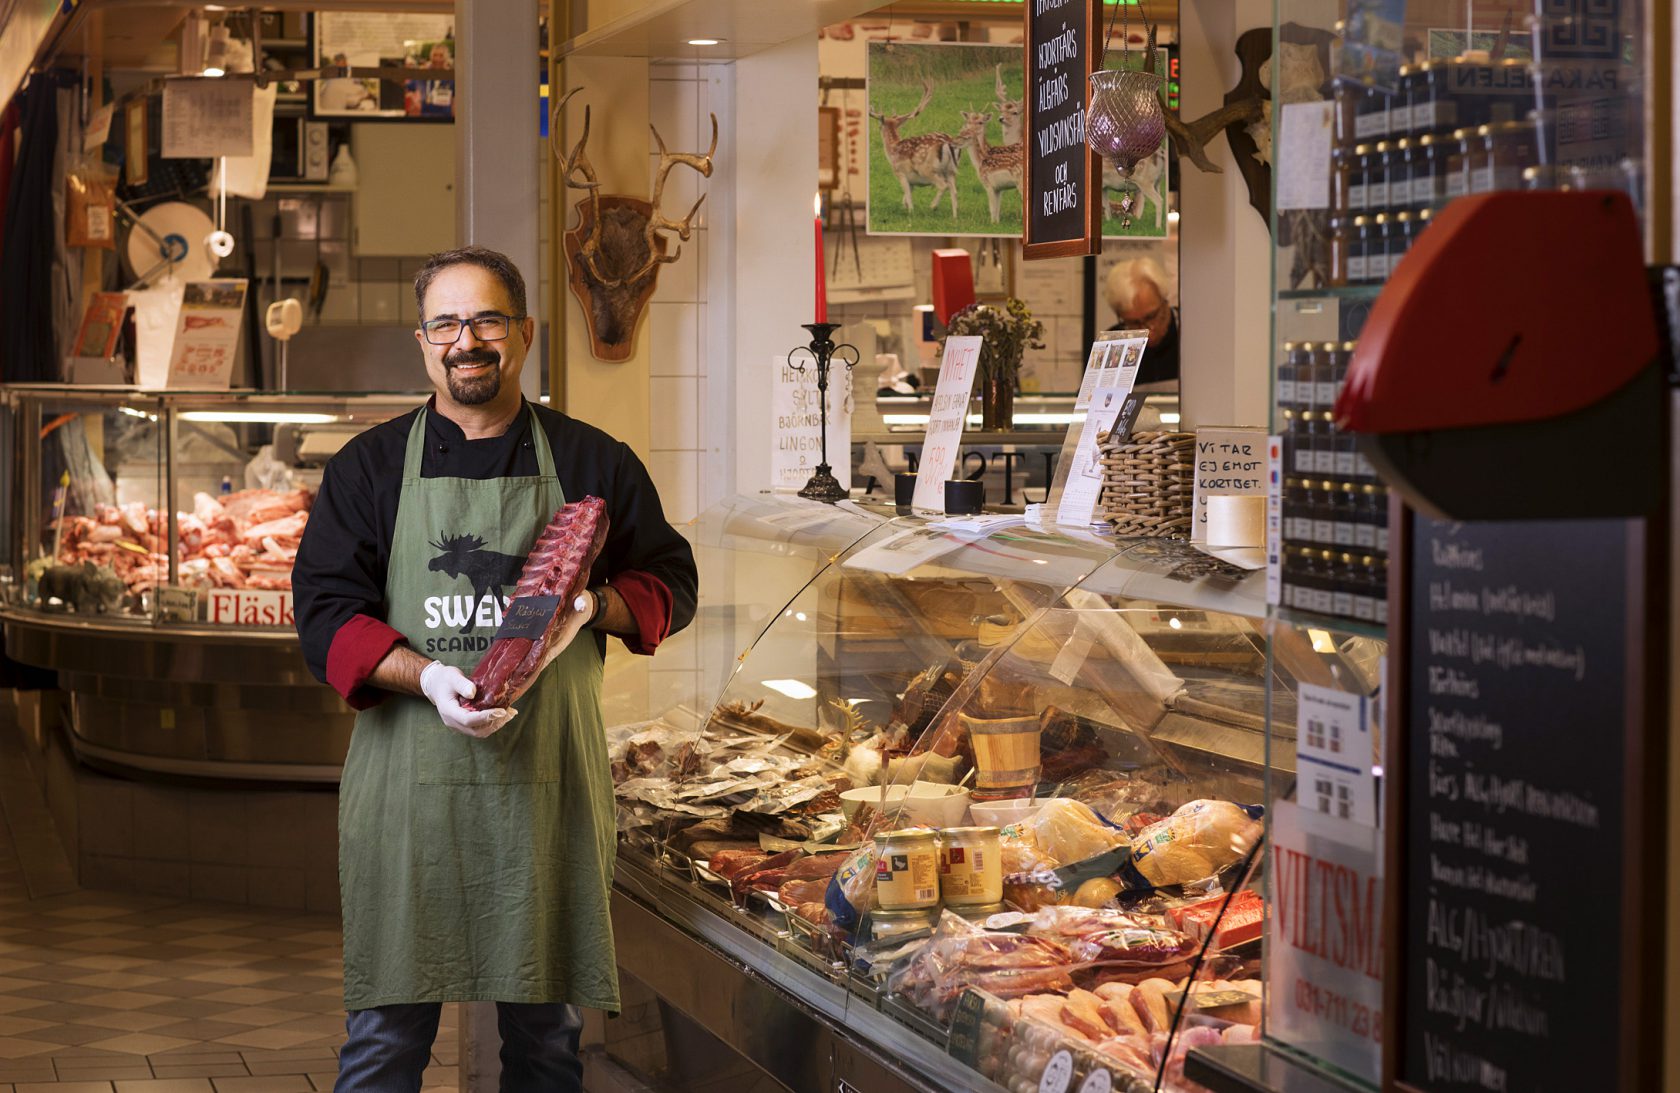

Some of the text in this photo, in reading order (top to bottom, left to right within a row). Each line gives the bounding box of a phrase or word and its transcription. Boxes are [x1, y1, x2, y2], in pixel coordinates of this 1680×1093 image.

[1219, 444, 1252, 456] TAR
[1198, 460, 1263, 473] EJ EMOT
